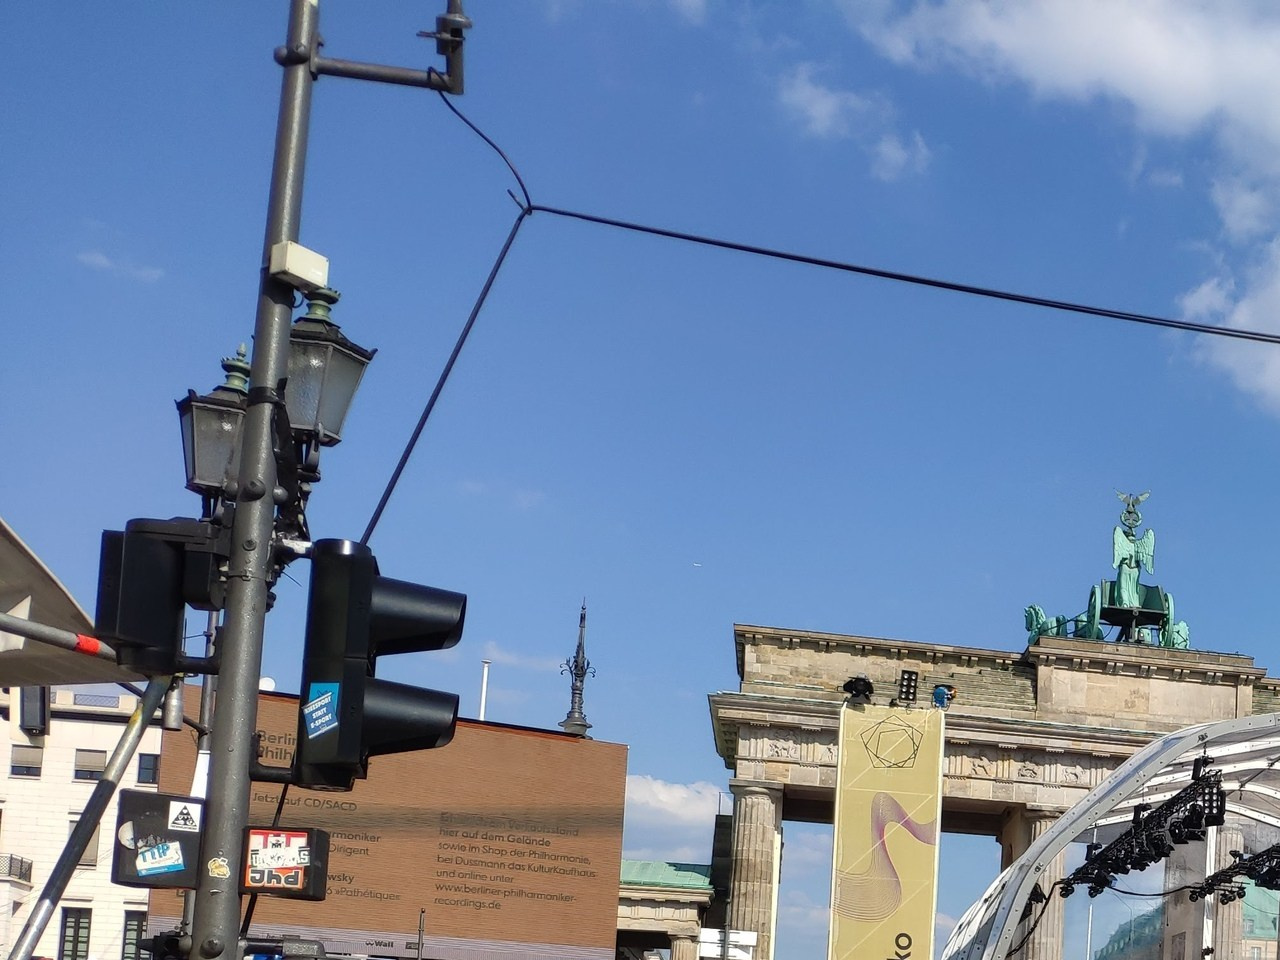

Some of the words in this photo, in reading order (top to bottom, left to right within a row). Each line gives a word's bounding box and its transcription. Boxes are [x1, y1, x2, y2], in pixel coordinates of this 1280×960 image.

[304, 798, 357, 811] CD/SACD
[439, 827, 459, 837] hier
[462, 831, 479, 839] auf
[481, 832, 504, 842] dem
[507, 834, 551, 847] Gelände
[438, 842, 466, 852] sowie
[469, 844, 480, 853] im
[482, 845, 508, 858] Shop
[510, 848, 527, 857] der
[528, 850, 592, 865] Philharmonie,
[437, 855, 453, 863] bei
[455, 856, 506, 869] Dussmann
[507, 861, 525, 871] das
[527, 863, 596, 878] KulturKaufhaus
[436, 869, 456, 878] und
[457, 871, 488, 881] online
[489, 874, 514, 883] unter
[434, 897, 501, 910] recordings.de
